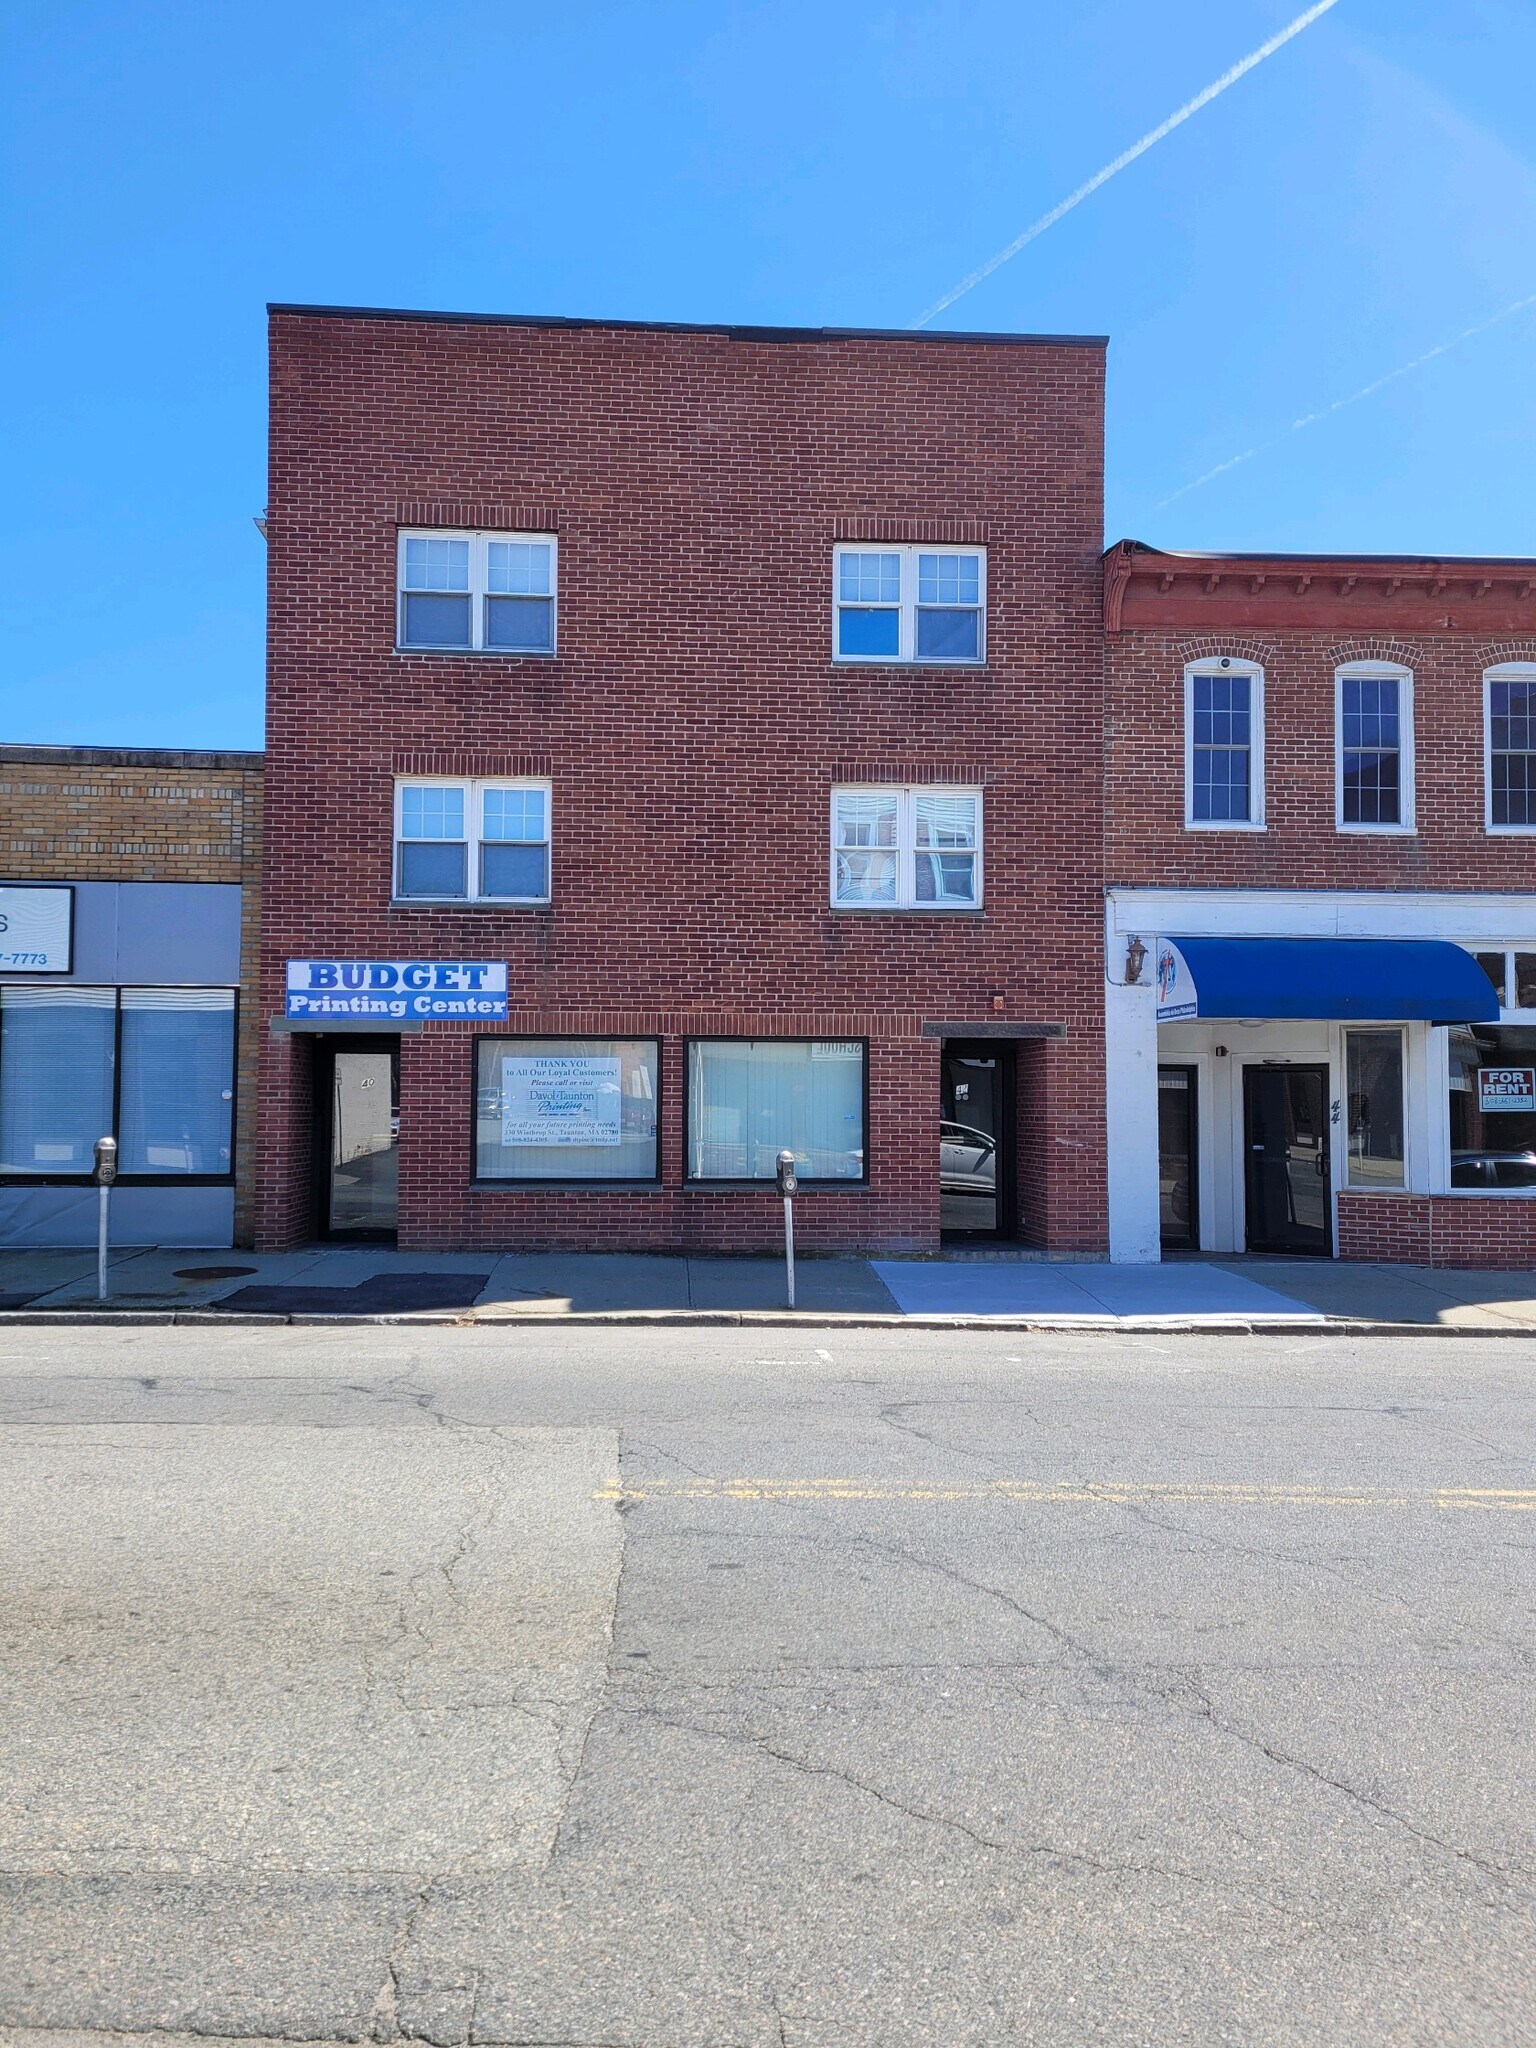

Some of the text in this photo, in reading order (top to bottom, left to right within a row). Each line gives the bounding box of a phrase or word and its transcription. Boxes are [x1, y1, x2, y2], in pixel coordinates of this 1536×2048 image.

[308, 963, 488, 989] BUDGET
[289, 995, 506, 1017] Printing Center
[548, 1069, 570, 1077] Loyal
[1489, 1072, 1525, 1083] FOR
[361, 1078, 375, 1088] 40
[1484, 1084, 1530, 1094] RENT
[537, 1101, 582, 1112] Printing
[506, 1121, 517, 1129] for
[545, 1121, 567, 1129] future
[568, 1121, 596, 1129] printing
